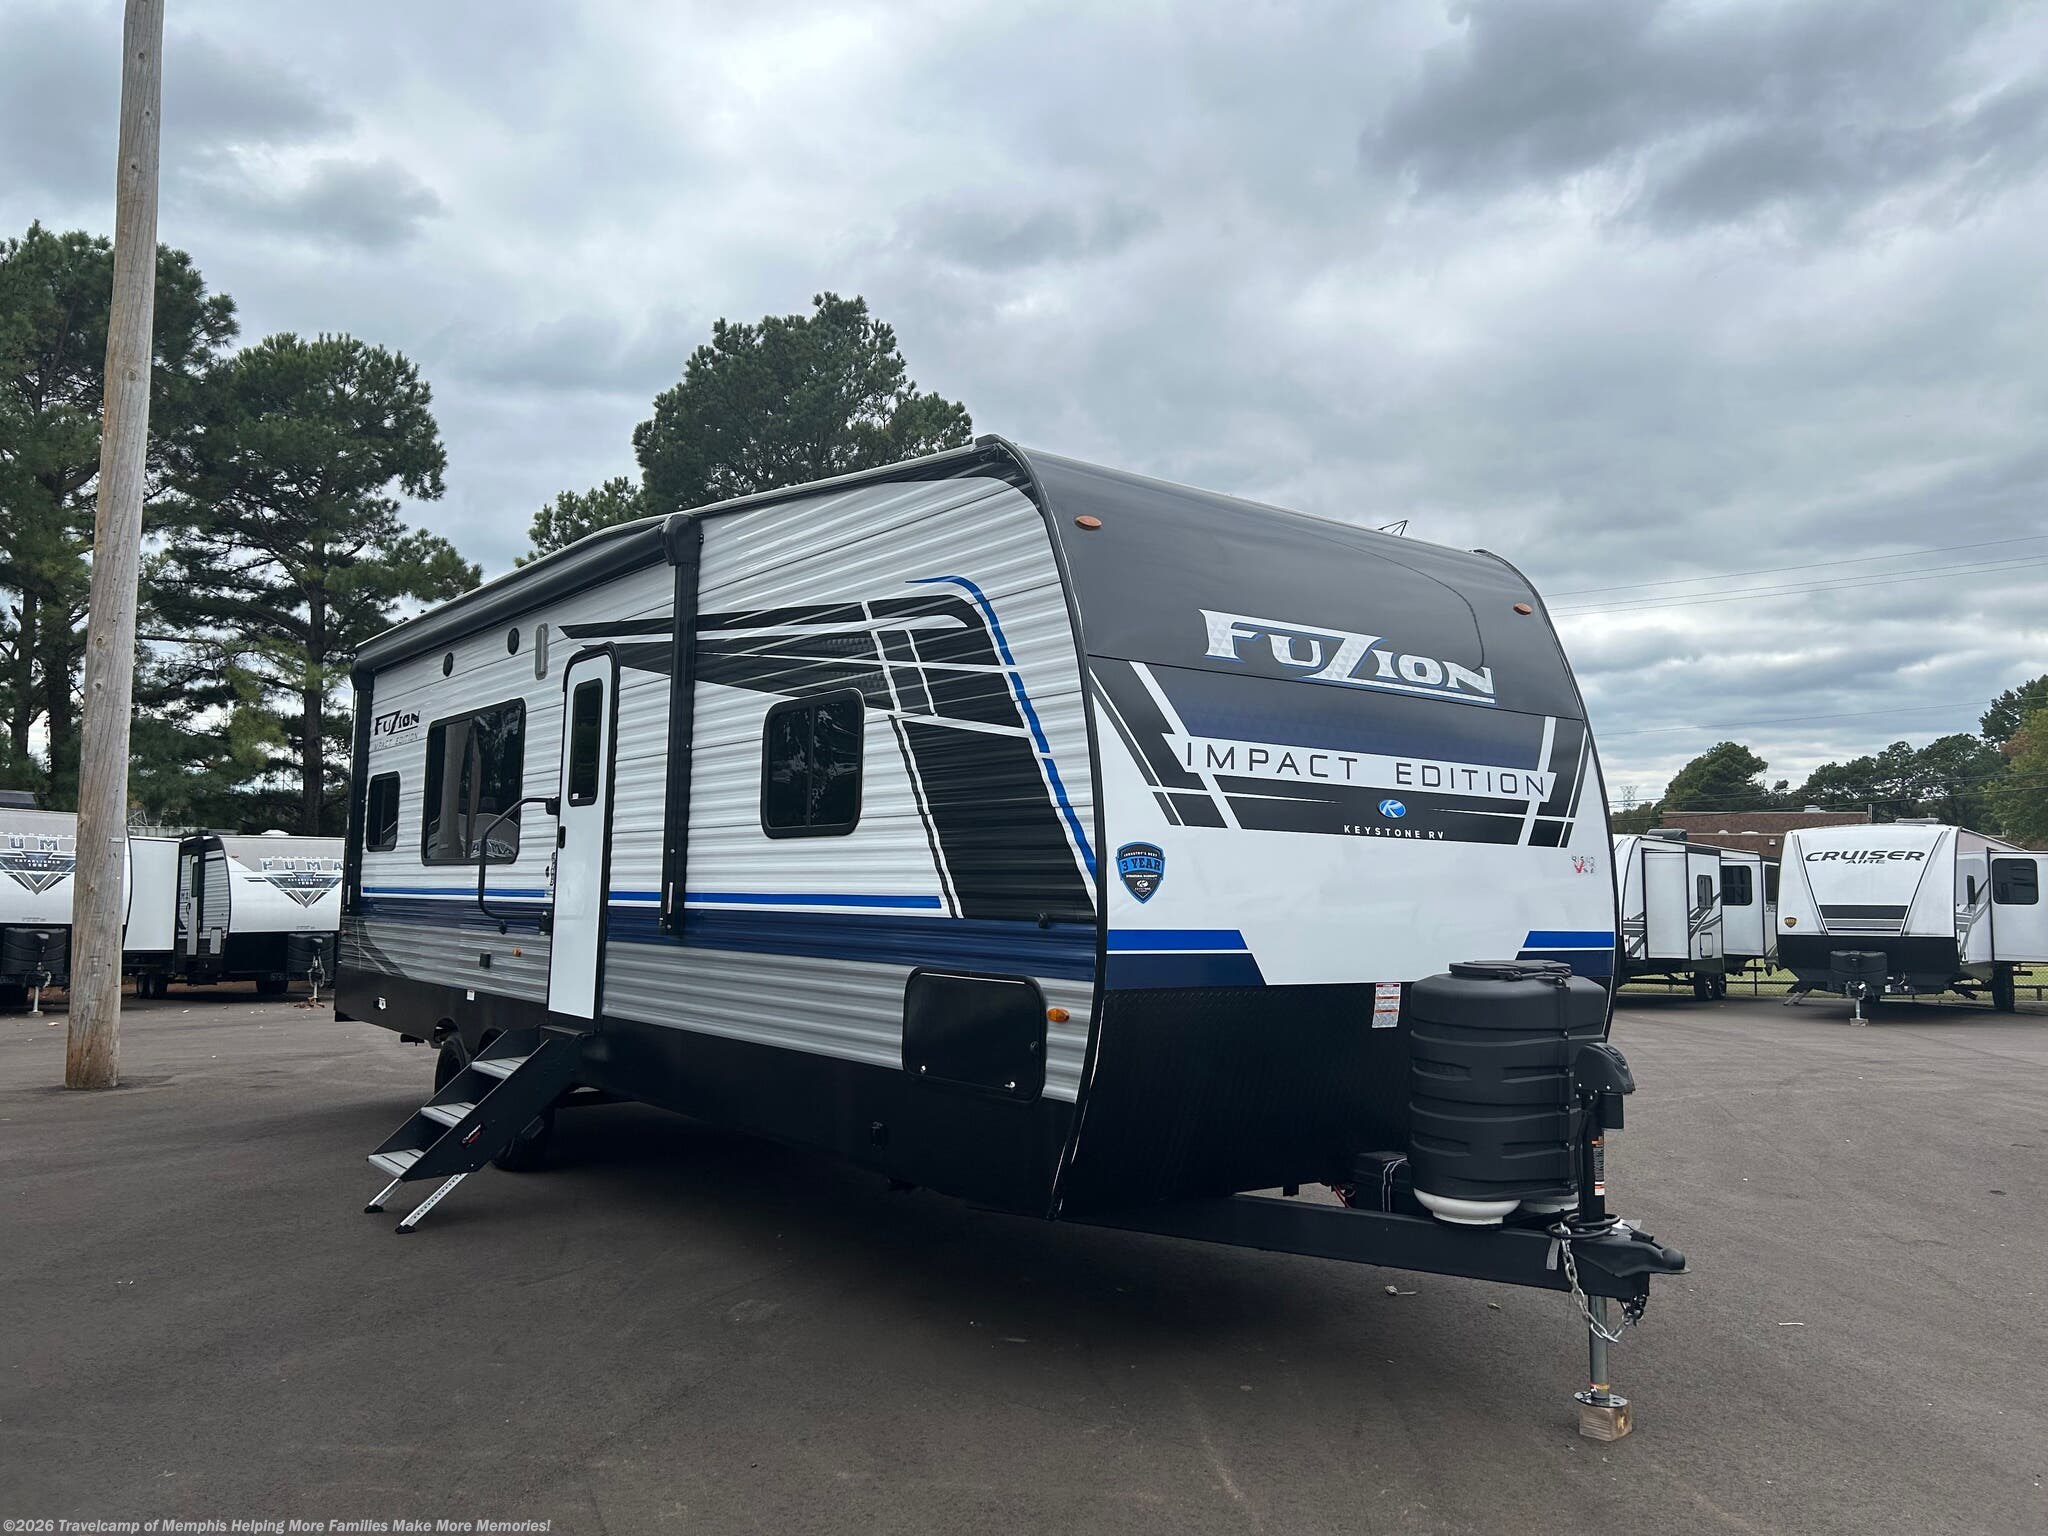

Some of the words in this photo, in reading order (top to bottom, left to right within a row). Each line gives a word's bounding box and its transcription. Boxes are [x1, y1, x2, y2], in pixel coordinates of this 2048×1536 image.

[1187, 742, 1358, 780] IMPACT
[1396, 762, 1544, 797] EDITION
[1343, 824, 1421, 839] KEYSTONE
[1428, 831, 1444, 840] RV
[1805, 850, 1925, 862] CRUISER
[262, 860, 344, 871] PUMA
[1122, 861, 1129, 871] 3
[1131, 857, 1161, 871] YEAR
